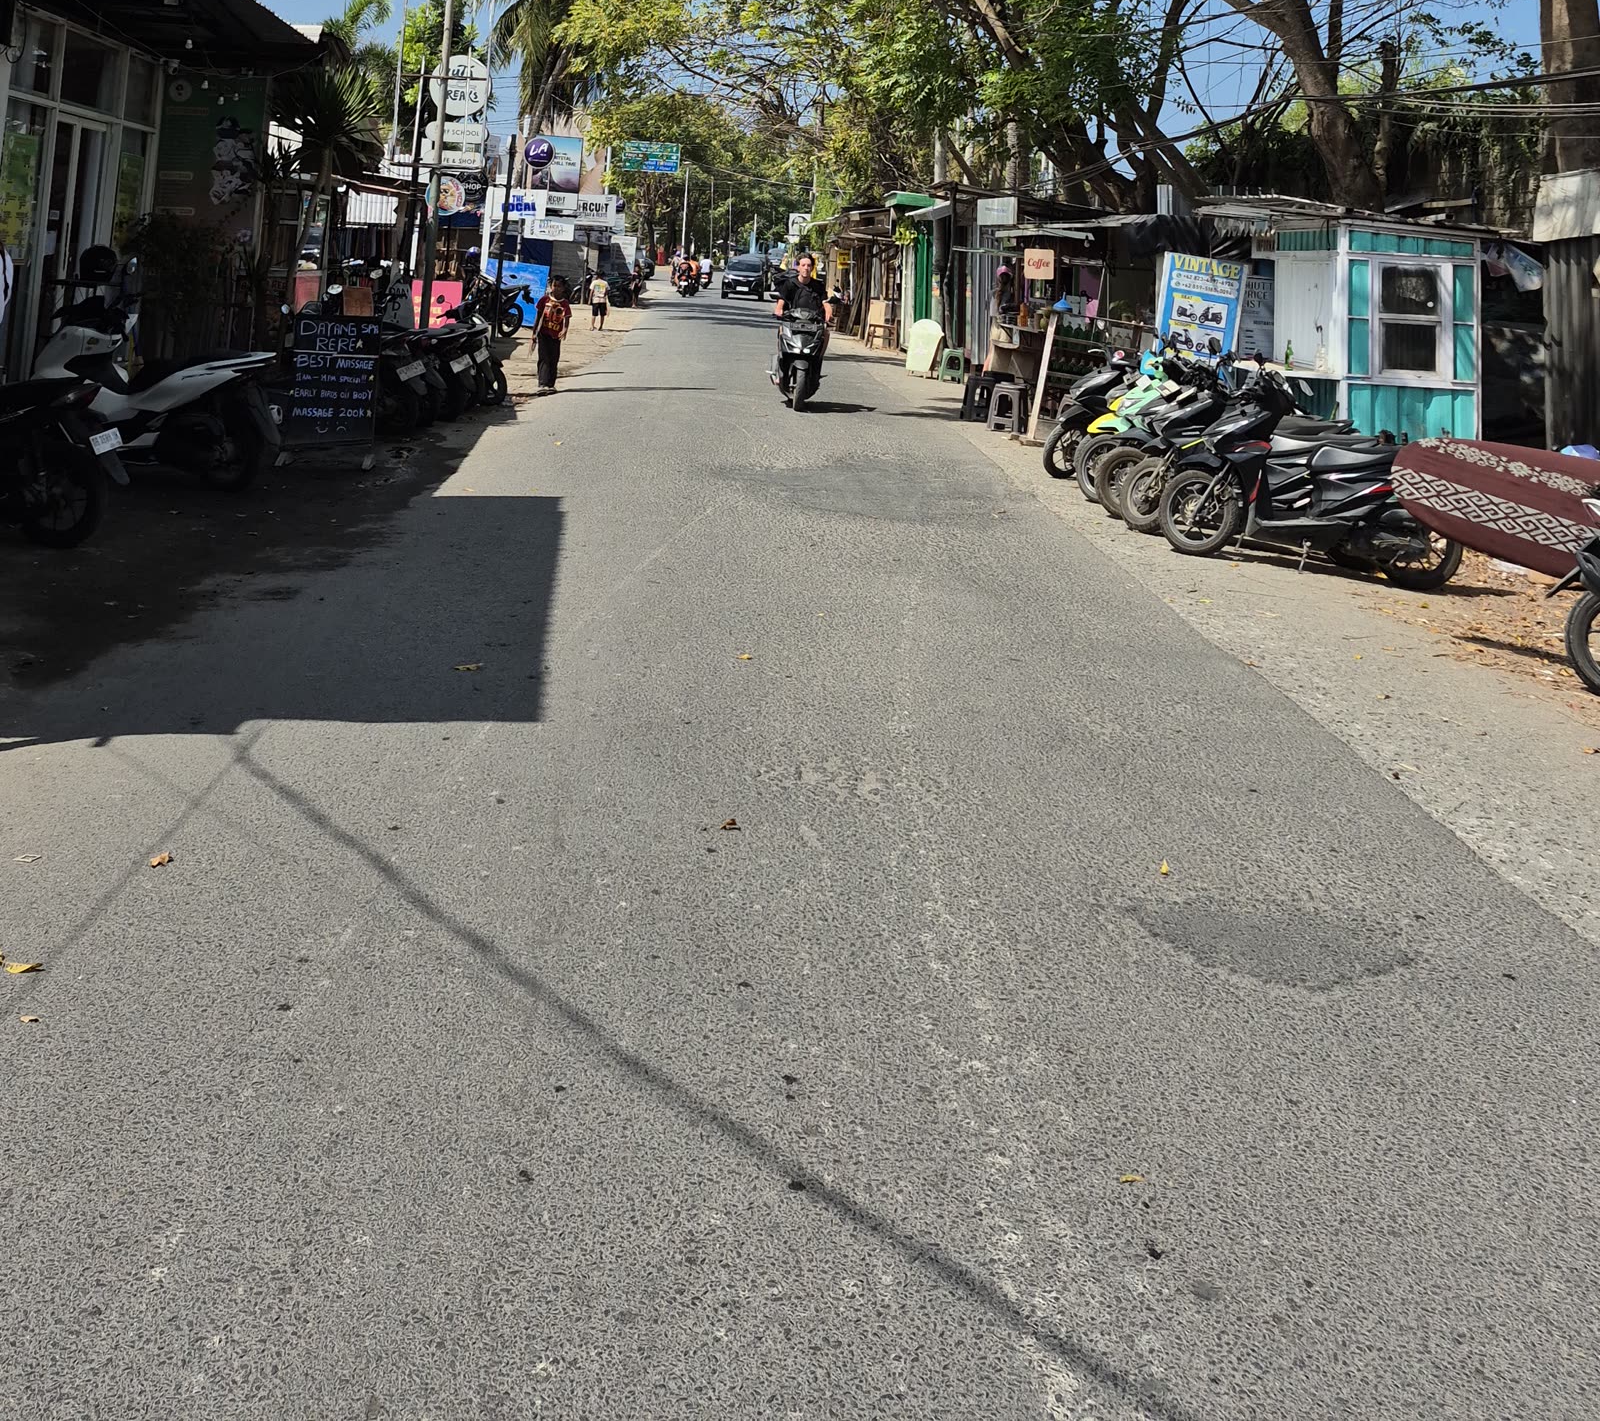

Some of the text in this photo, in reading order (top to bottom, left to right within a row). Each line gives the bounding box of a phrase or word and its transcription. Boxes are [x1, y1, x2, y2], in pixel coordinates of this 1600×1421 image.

[1027, 258, 1051, 270] Coffee
[1174, 254, 1240, 280] VINTAGE
[300, 319, 357, 337] DAYANG
[315, 337, 356, 352] RERE
[296, 354, 375, 369] BEST MASSAGE
[294, 387, 317, 398] EARLY
[291, 407, 334, 418] MASSAGE
